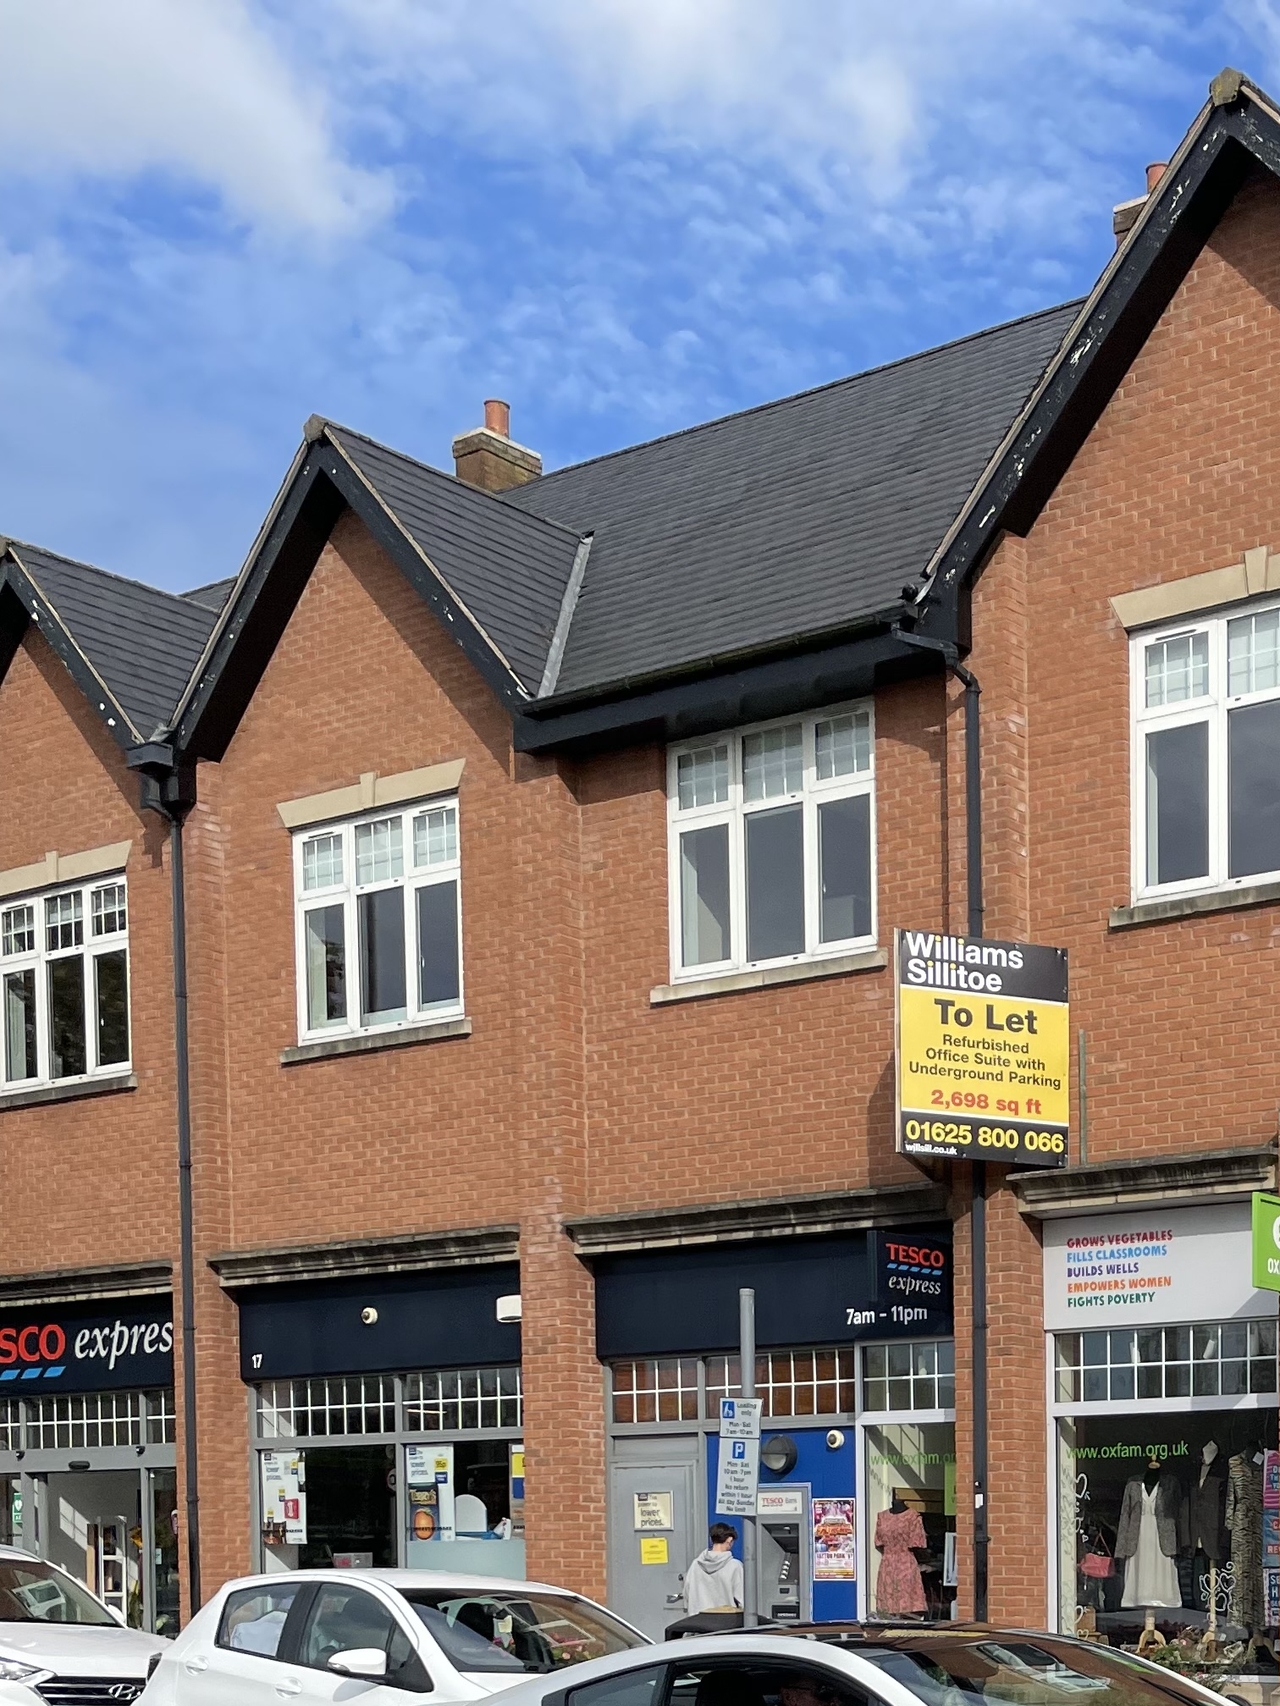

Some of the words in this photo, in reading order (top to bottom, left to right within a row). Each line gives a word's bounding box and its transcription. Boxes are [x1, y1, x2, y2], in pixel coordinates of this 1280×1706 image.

[906, 932, 1024, 968] Williams
[907, 959, 1002, 992] Sillitoe
[934, 998, 973, 1027] To
[986, 1004, 1038, 1034] Let
[942, 1034, 1030, 1054] Refurbished
[926, 1048, 969, 1064] Office
[974, 1052, 1011, 1068] Suite
[1016, 1058, 1046, 1072] with
[909, 1061, 1004, 1083] Underground
[1009, 1072, 1061, 1090] Parking
[931, 1090, 989, 1109] 2,698
[996, 1098, 1018, 1116] sq
[1026, 1098, 1042, 1114] ft
[906, 1120, 972, 1144] 01625
[978, 1126, 1018, 1148] 800
[1024, 1131, 1064, 1153] 066
[1066, 1235, 1104, 1248] GROWS
[1108, 1230, 1173, 1245] VEGETABLES
[886, 1243, 944, 1268] TESCO
[1066, 1250, 1093, 1262] FILLS
[1096, 1244, 1168, 1260] CLASSROOMS
[1067, 1265, 1103, 1278] BUILDS
[1106, 1262, 1140, 1274] WELLS
[888, 1276, 941, 1295] express
[1068, 1279, 1126, 1293] EMPOWERS
[1128, 1276, 1172, 1288] WOMEN
[1068, 1295, 1104, 1308] FIGHTS
[1108, 1292, 1156, 1305] POVERTY
[846, 1308, 876, 1324] 7am
[891, 1306, 928, 1325] 11pm
[74, 1320, 174, 1370] expres
[252, 1354, 262, 1368] 17
[735, 1443, 744, 1458] P
[1066, 1440, 1189, 1460] www.oxfam.org.uk
